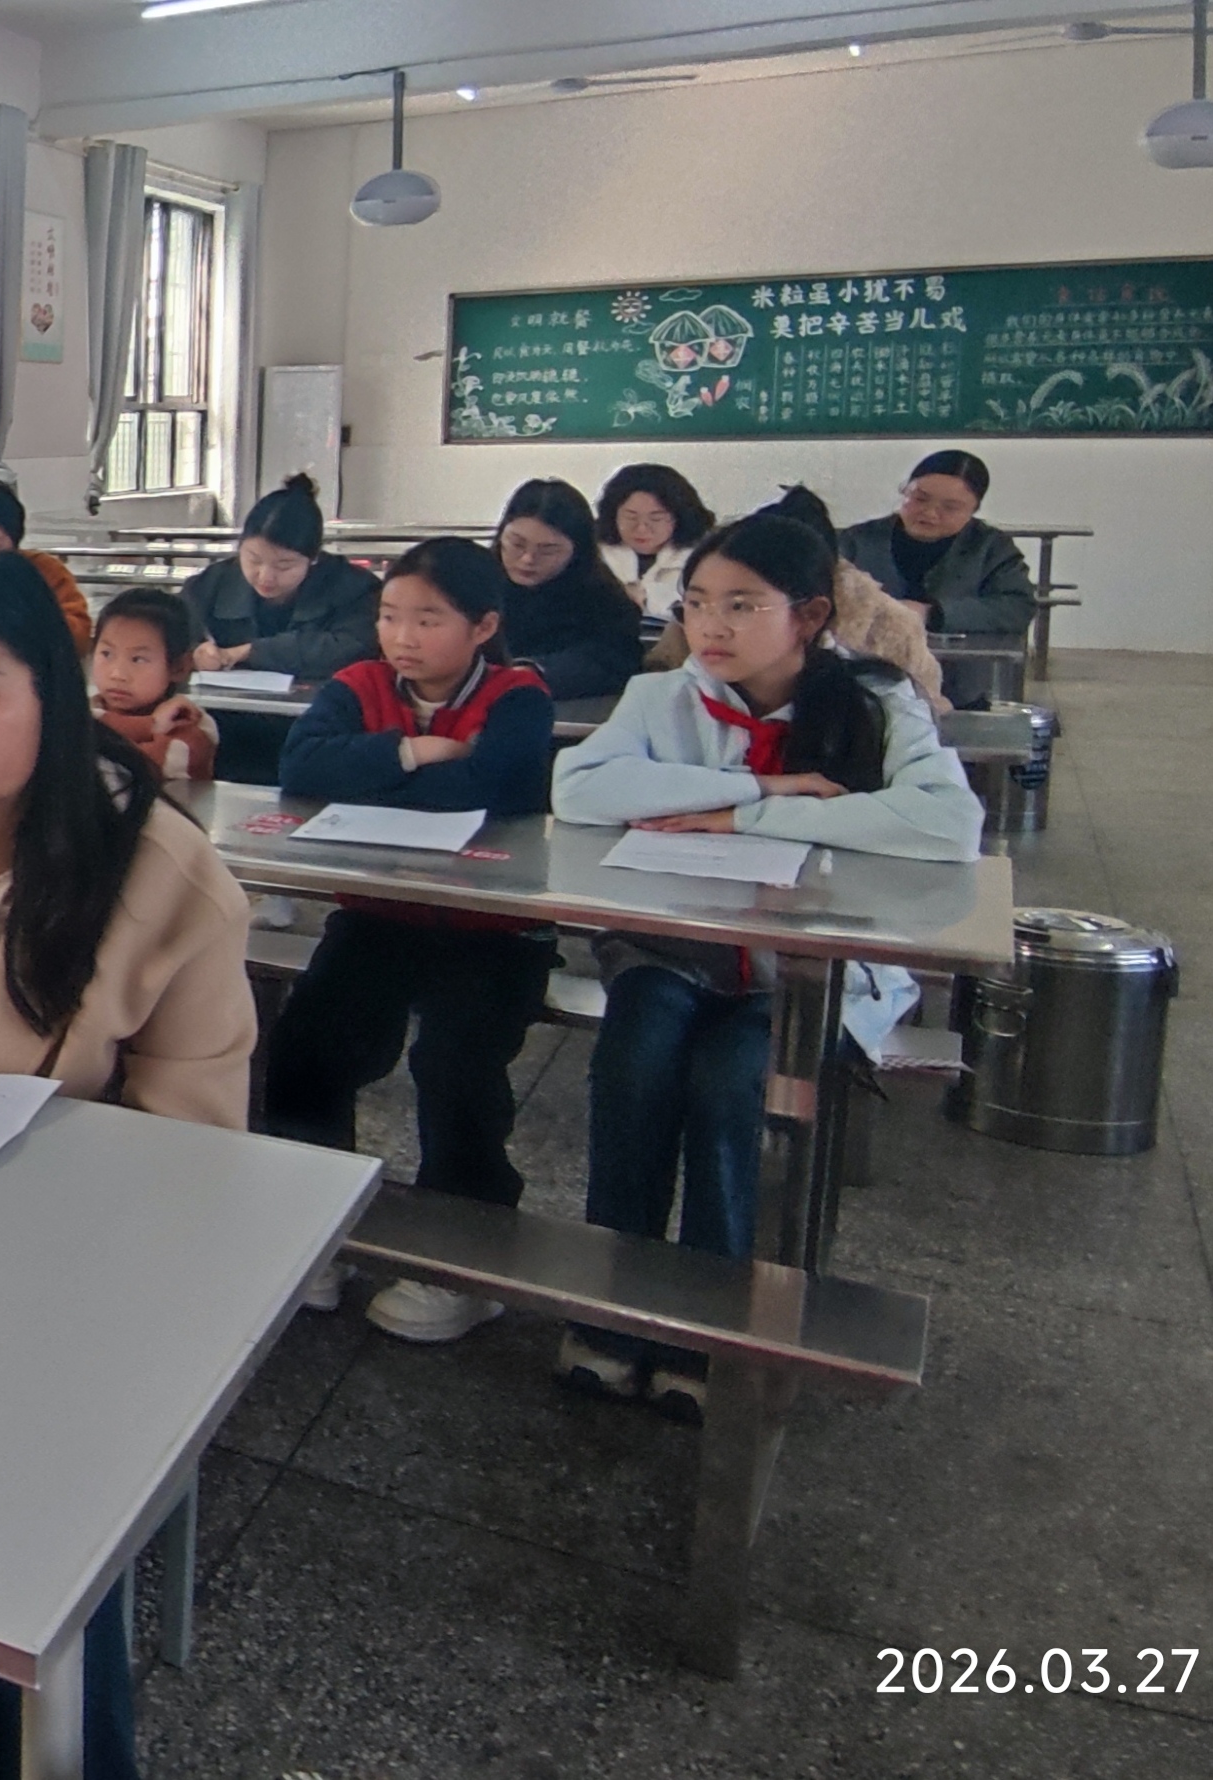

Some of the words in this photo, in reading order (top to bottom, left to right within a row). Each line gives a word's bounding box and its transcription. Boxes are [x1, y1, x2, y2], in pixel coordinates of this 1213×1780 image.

[751, 275, 946, 309] 米粒虽小犹不易
[510, 309, 592, 330] 文明就餐
[769, 305, 968, 340] 莫把辛苦当儿戏
